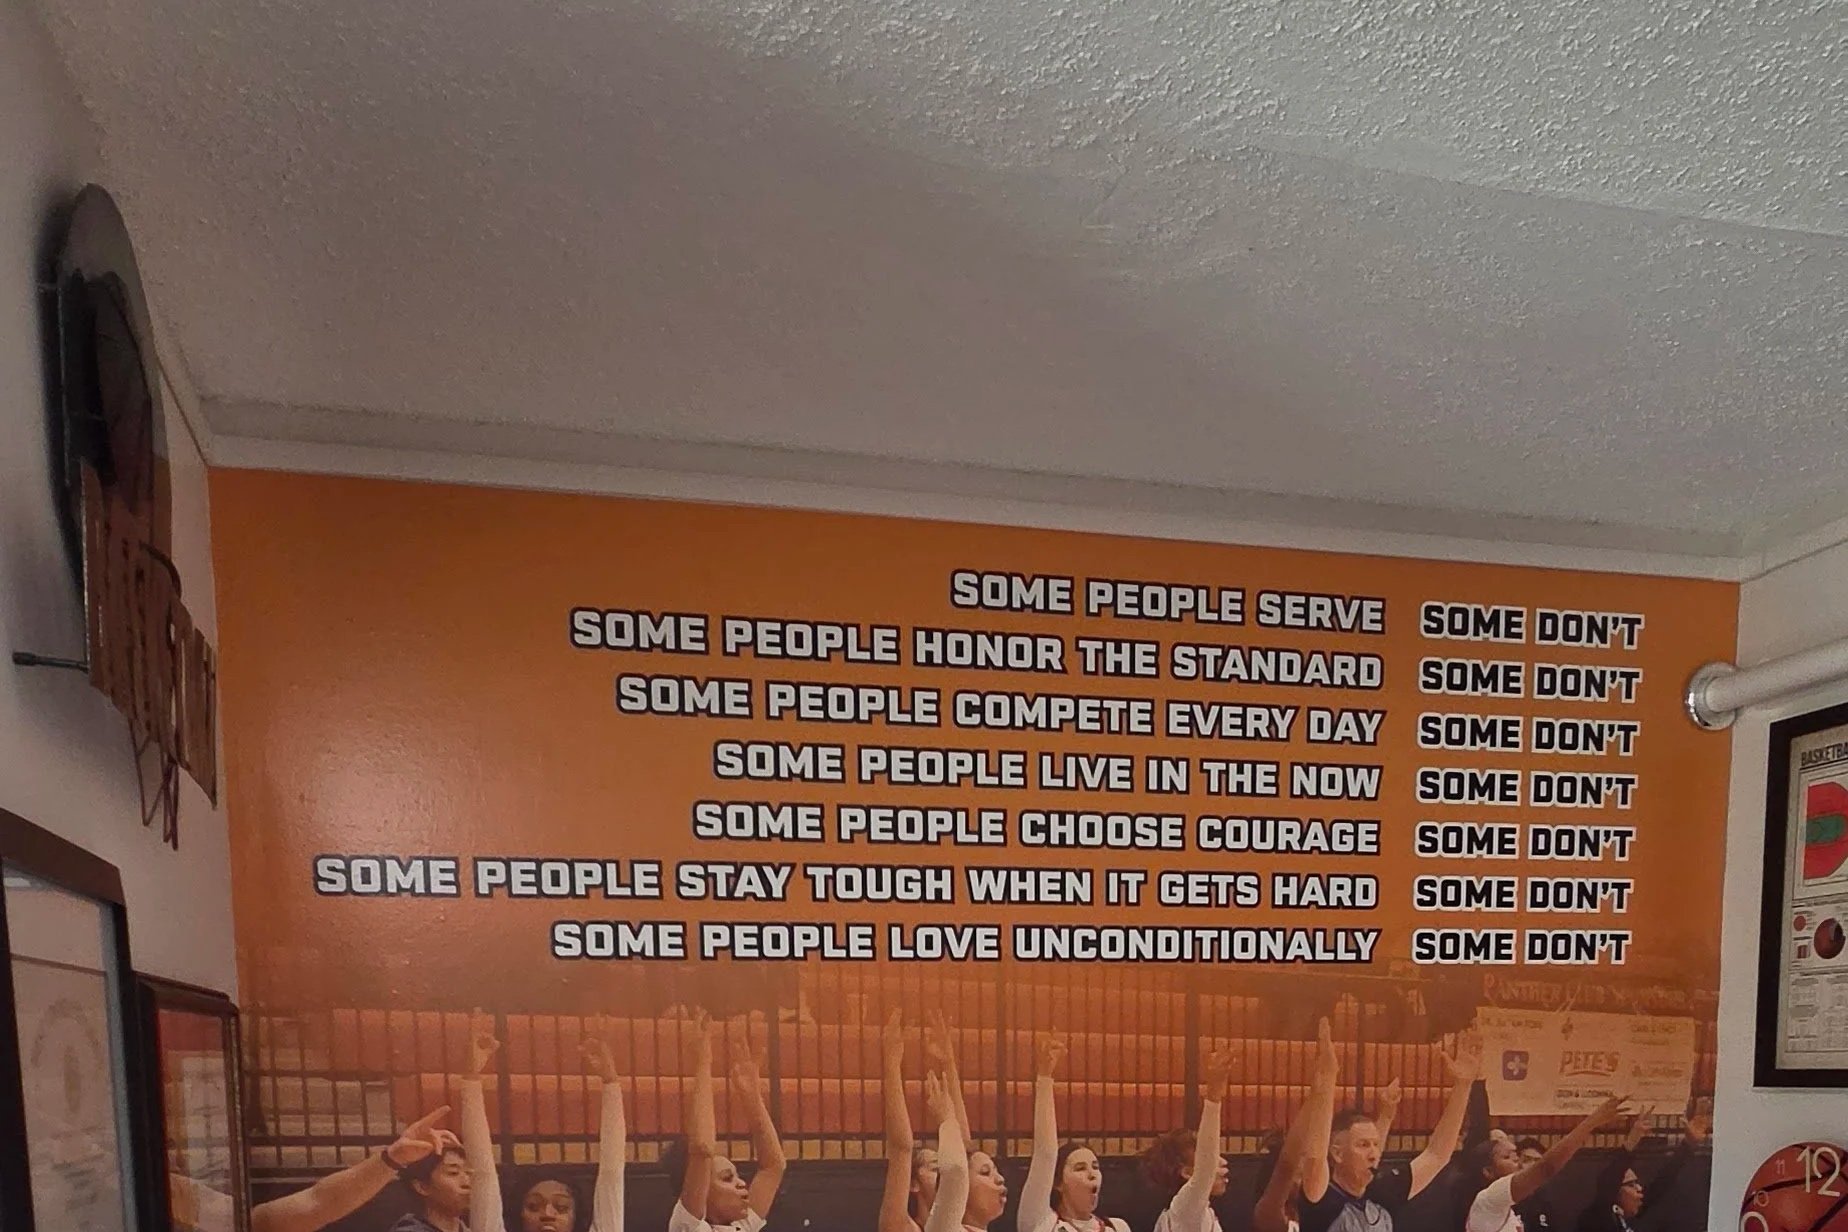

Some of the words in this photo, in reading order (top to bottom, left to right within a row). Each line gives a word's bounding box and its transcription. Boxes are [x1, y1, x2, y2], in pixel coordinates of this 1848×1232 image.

[952, 572, 1072, 613] SOME
[1086, 581, 1243, 624] PEOPLE
[1258, 592, 1383, 633] SERVE
[1421, 604, 1523, 641] SOME
[1537, 610, 1641, 647] DON'T
[570, 610, 707, 654] SOME
[724, 619, 898, 663] PEOPLE
[914, 630, 1063, 672] HONOR
[1077, 639, 1158, 676] THE
[1173, 645, 1382, 688] STANDARD
[1420, 660, 1522, 695] SOME
[1535, 666, 1639, 701] DON'T
[617, 676, 751, 716] SOME
[767, 683, 938, 725] PEOPLE
[954, 692, 1153, 734] COMPETE
[1166, 702, 1296, 740] EVERY
[1308, 709, 1383, 744] DAY
[1419, 715, 1519, 750] SOME
[1533, 720, 1637, 754] DON'T
[714, 742, 843, 781] SOME
[859, 748, 1025, 787] PEOPLE
[1039, 754, 1132, 790] LIVE
[1147, 759, 1188, 792] IN
[1201, 761, 1278, 795] THE
[1291, 764, 1380, 799] NOW
[1418, 770, 1519, 804] SOME
[1531, 773, 1635, 807] DON'T
[693, 802, 823, 840] SOME
[839, 807, 1004, 844] PEOPLE
[1020, 813, 1183, 849] CHOOSE
[1198, 817, 1378, 854] COURAGE
[1417, 824, 1515, 858] SOME
[1529, 827, 1632, 860] DON'T
[314, 855, 458, 897] SOME
[474, 858, 659, 898] PEOPLE
[676, 862, 791, 899] STAY
[805, 865, 952, 901] TOUGH
[968, 869, 1091, 903] WHEN
[1106, 871, 1146, 905] IT
[1159, 872, 1259, 906] GETS
[1273, 875, 1377, 908] HARD
[1415, 877, 1514, 910] SOME
[1527, 879, 1630, 912] DON'T
[551, 921, 684, 958] SOME
[700, 924, 874, 959] PEOPLE
[889, 926, 999, 959] LOVE
[1013, 926, 1377, 962] UNCONDITIONALLY
[1414, 931, 1513, 962] SOME
[1526, 931, 1630, 964] DON'T
[1775, 1159, 1785, 1175] 11
[1796, 1146, 1841, 1197] 12
[1752, 1190, 1769, 1207] 10
